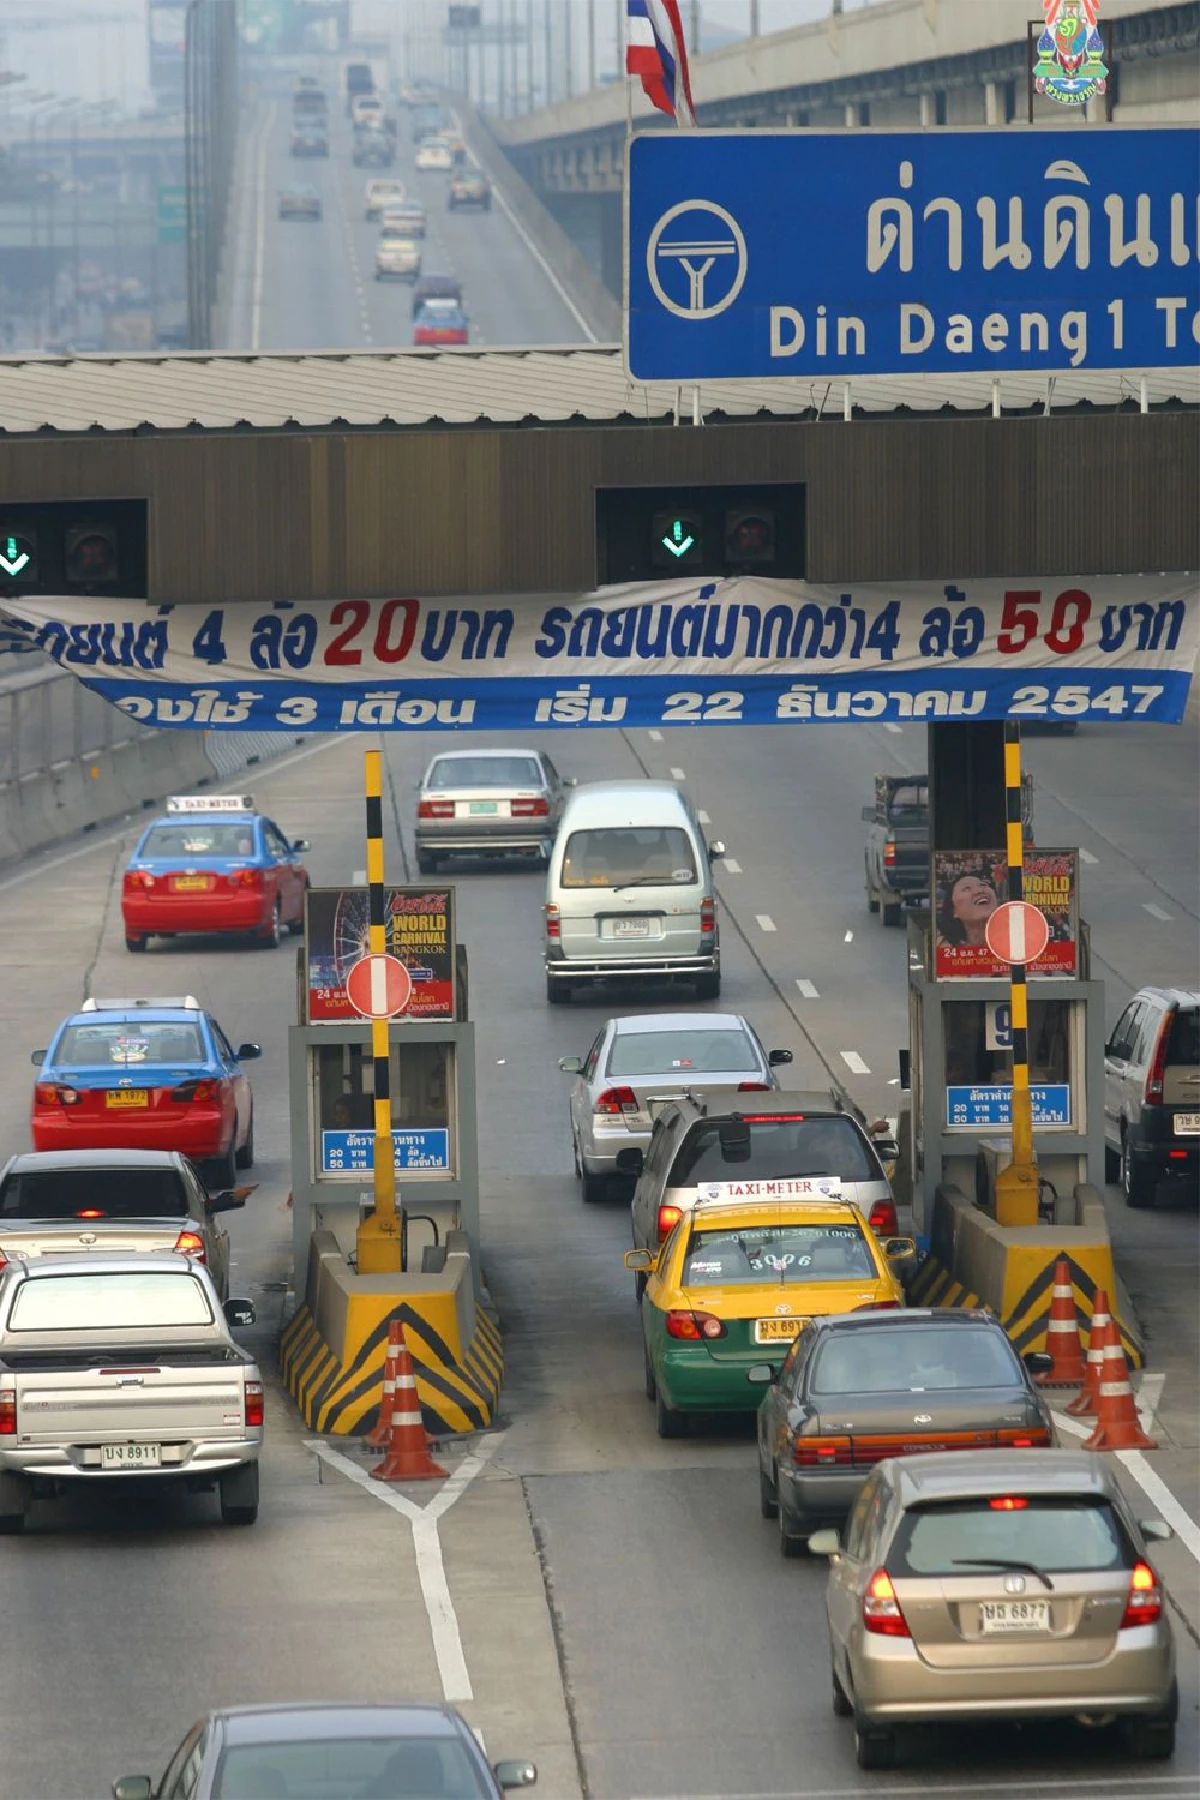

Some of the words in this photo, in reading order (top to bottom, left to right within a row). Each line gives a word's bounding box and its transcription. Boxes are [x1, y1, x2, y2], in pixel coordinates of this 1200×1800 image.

[769, 305, 866, 357] Din
[900, 304, 1090, 366] Daeng
[1107, 299, 1123, 349] 1
[193, 610, 227, 665] 4
[250, 600, 318, 669] ล้อ
[324, 598, 420, 666] 20
[420, 610, 515, 662] บาท
[918, 585, 986, 659] ล้อ
[996, 588, 1092, 655] 50
[1098, 600, 1186, 653] บาท
[276, 696, 318, 724] 3
[339, 690, 476, 726] เดือน
[534, 683, 629, 723] เริ่ม
[661, 691, 744, 721] 22
[777, 684, 987, 720] ธันวาคม
[1008, 684, 1165, 717] 2547
[1026, 892, 1069, 905] ARNIVAL
[393, 914, 447, 931] WORLD
[393, 931, 447, 944] CARNIVAL
[393, 945, 446, 954] BANGKOK
[995, 1004, 1014, 1047] 9
[127, 1446, 156, 1459] 8911
